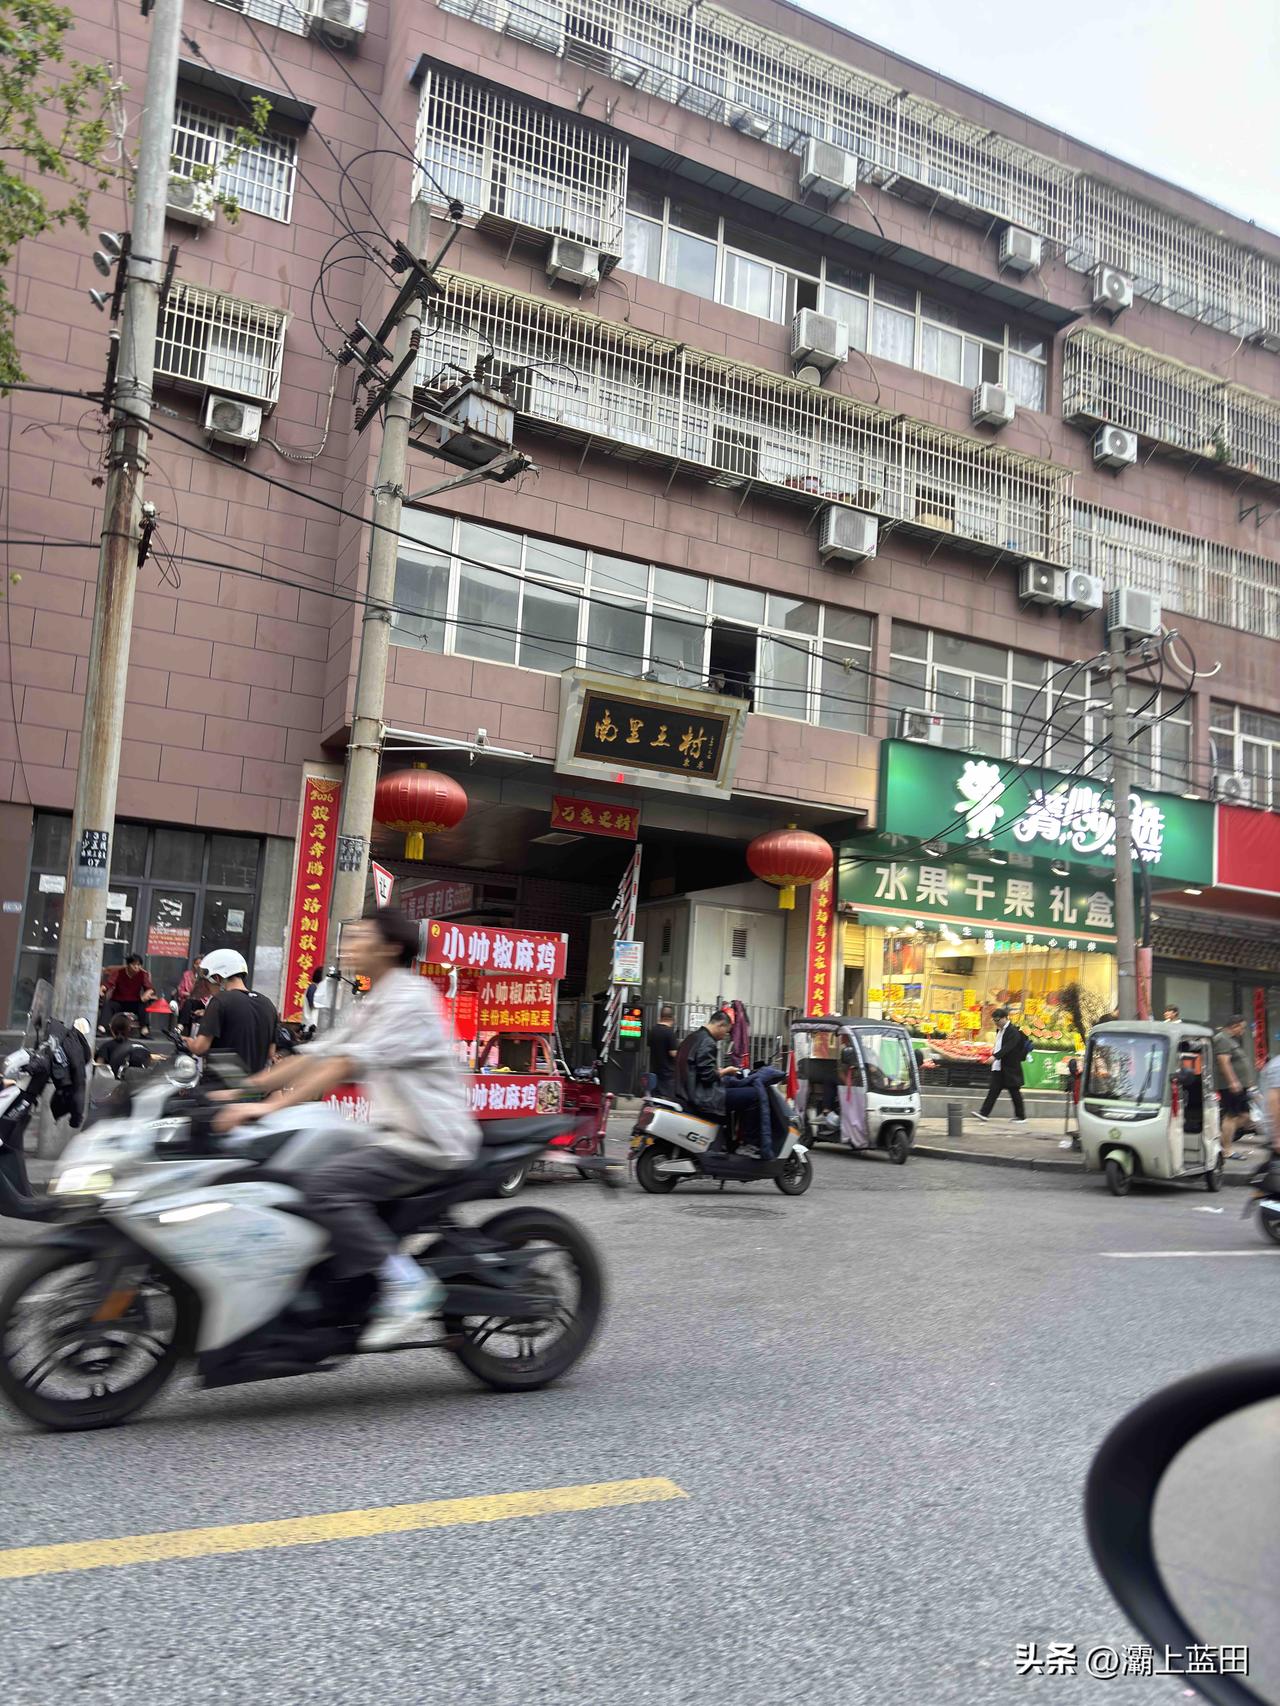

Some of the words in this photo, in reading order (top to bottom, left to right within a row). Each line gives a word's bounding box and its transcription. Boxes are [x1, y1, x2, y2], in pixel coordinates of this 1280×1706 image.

[594, 708, 707, 759] 南里王村
[309, 789, 334, 804] 2026
[442, 926, 557, 975] 小帅椒麻鸡
[481, 980, 553, 1006] 小帅椒麻鸡
[480, 1008, 551, 1027] 半份鸡+5种配菜
[465, 1083, 537, 1112] 帅椒麻鸡
